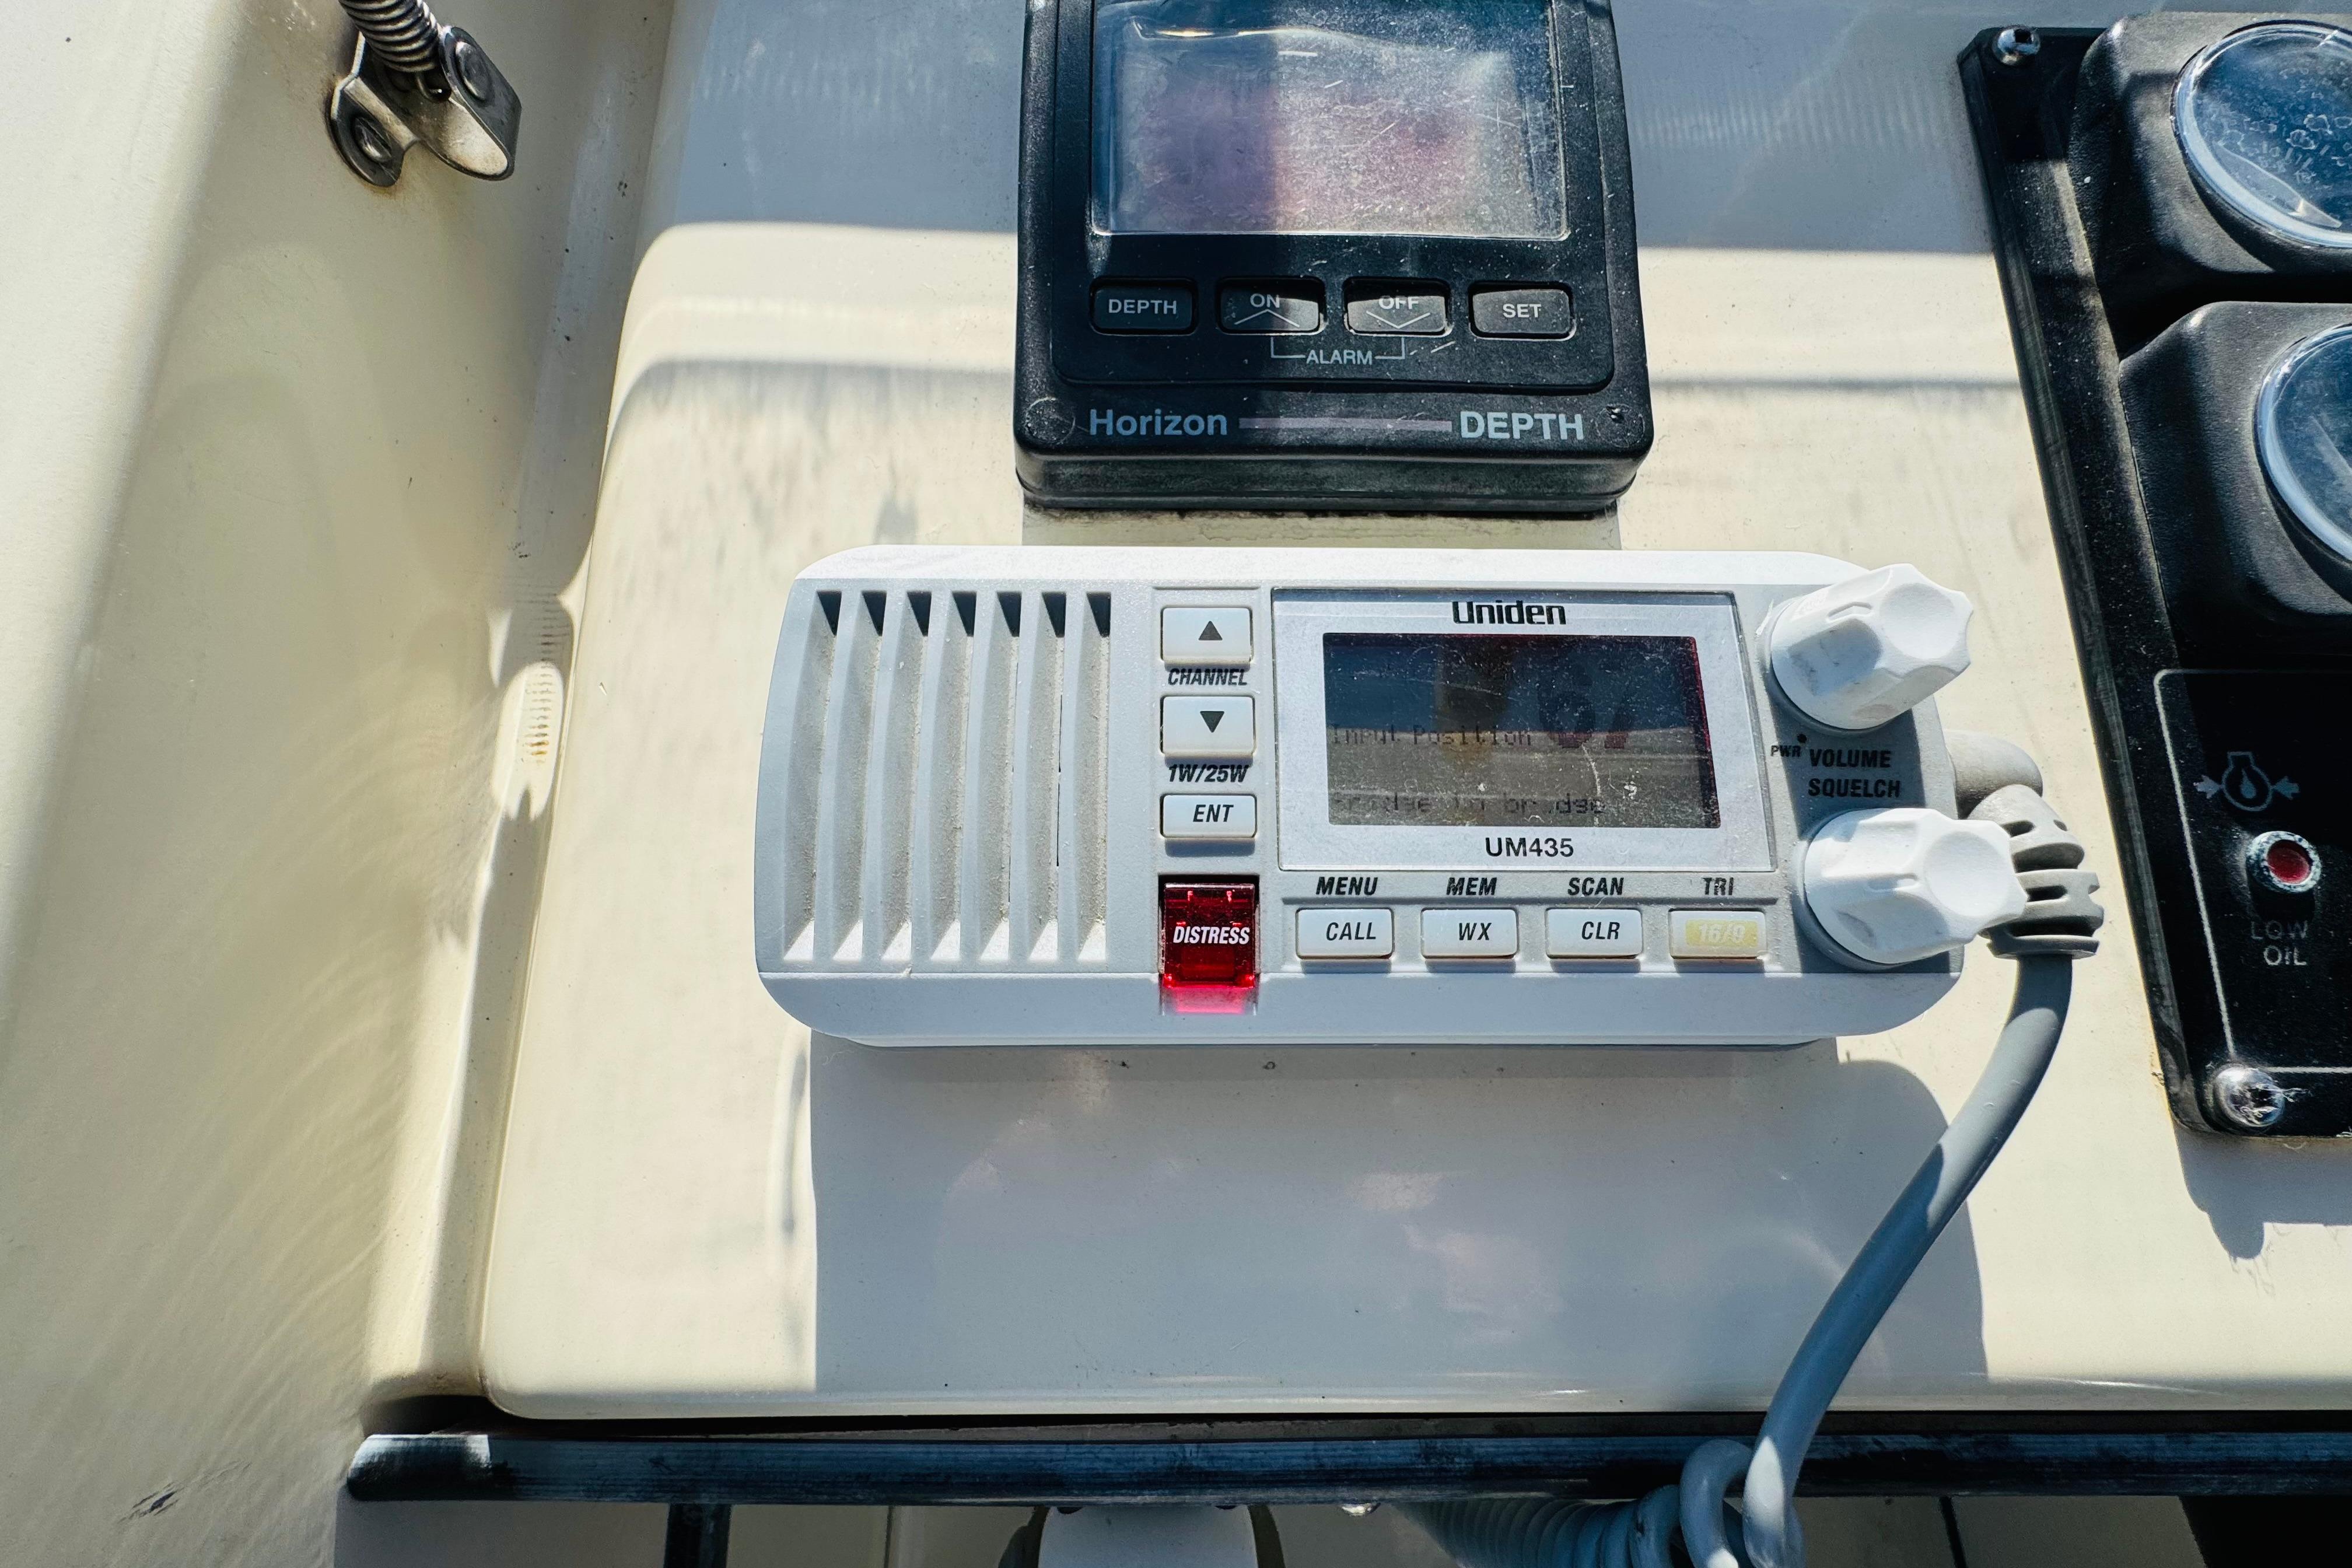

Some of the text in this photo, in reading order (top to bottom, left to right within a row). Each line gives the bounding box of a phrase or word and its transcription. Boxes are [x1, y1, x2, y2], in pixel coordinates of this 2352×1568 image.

[1108, 299, 1178, 315] DEPTH
[1249, 293, 1281, 309] ON
[1378, 296, 1420, 310] OFF
[1502, 303, 1542, 319] SET
[1306, 349, 1373, 366] ALARM
[1088, 408, 1228, 438] Horizon
[1460, 411, 1583, 441] DEPTH
[1452, 601, 1567, 625] Uniden
[1168, 668, 1248, 686] CHANNEL
[1770, 745, 1801, 757] PWR
[1810, 748, 1891, 768] VOLUME
[1168, 764, 1248, 783] 1W/25W
[1808, 778, 1901, 798] SQUELCH
[1193, 804, 1234, 822] ENT
[1485, 838, 1574, 858] UM435
[1316, 877, 1378, 895] MENU
[1447, 877, 1497, 895] MEM
[1567, 877, 1624, 896] SCAN
[1704, 877, 1734, 895] TRI
[1172, 926, 1250, 945] DISTRESS
[1326, 922, 1377, 940] CALL
[1459, 922, 1492, 940] WX
[1581, 922, 1620, 940] CLR
[1698, 923, 1746, 943] 16/9
[2251, 921, 2308, 940] LOW
[2263, 945, 2307, 965] OIL
